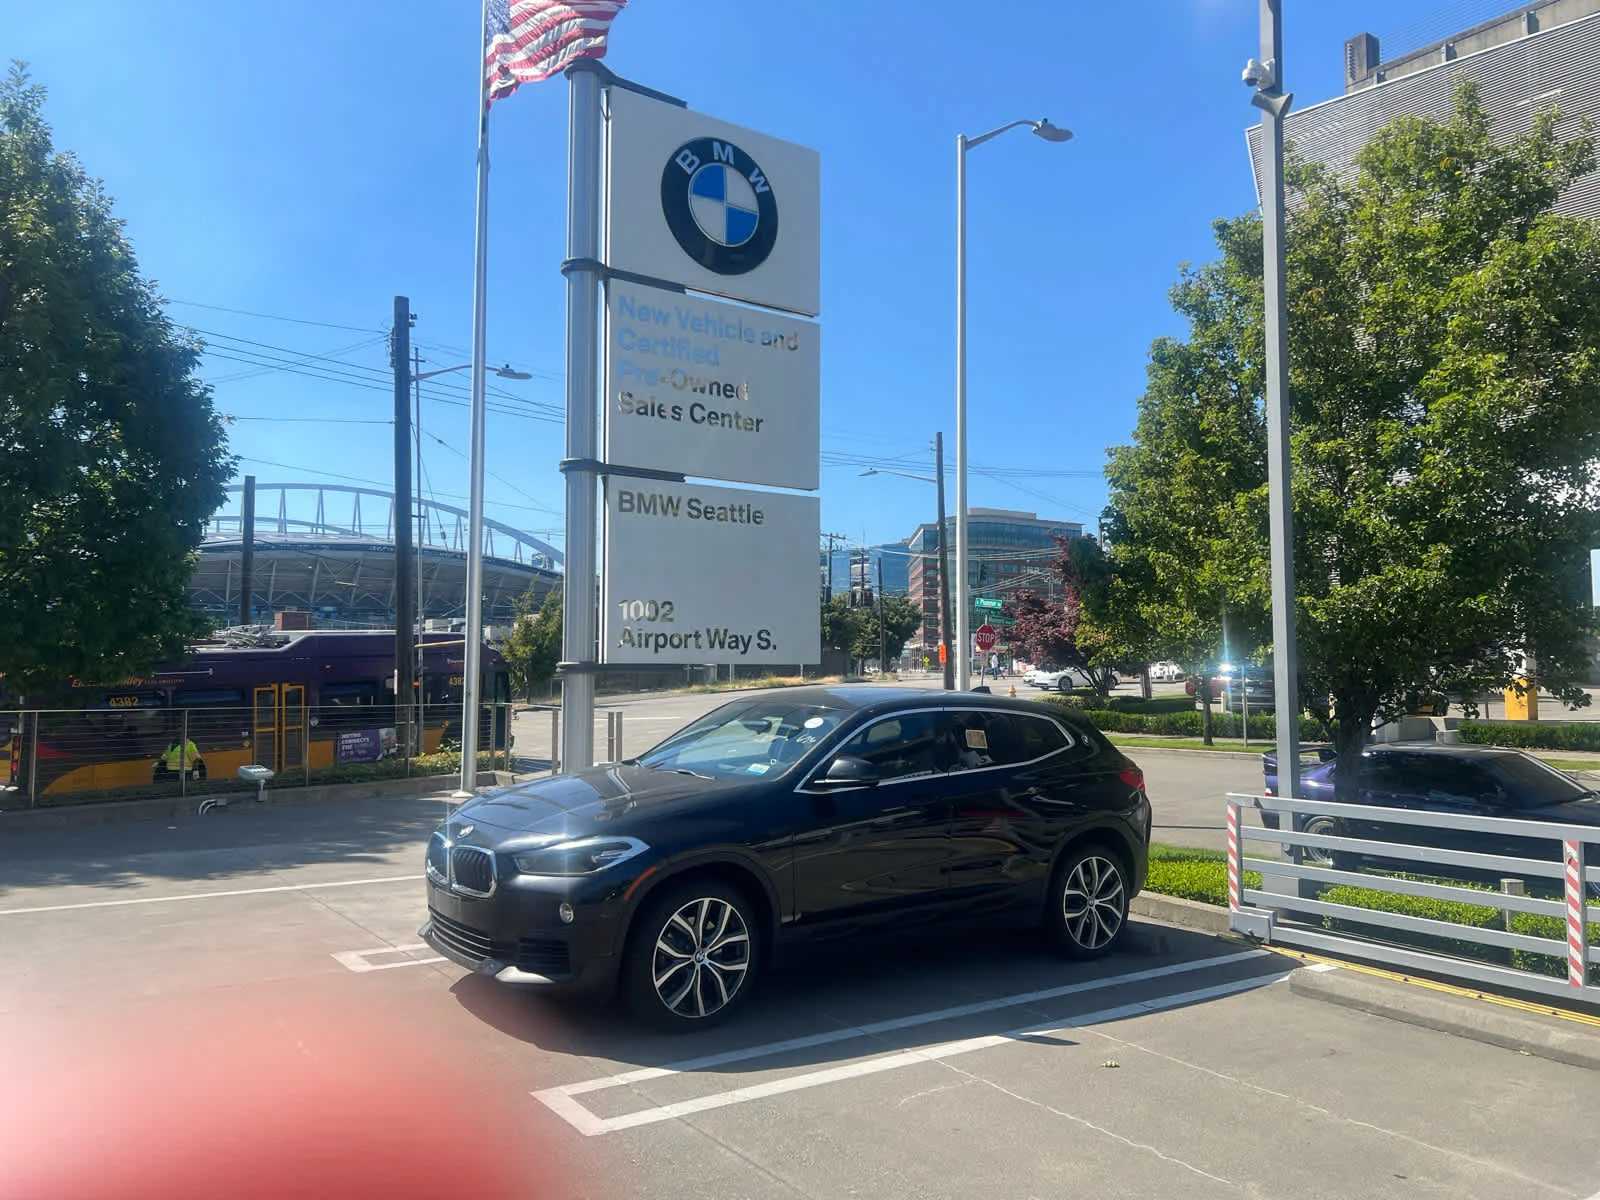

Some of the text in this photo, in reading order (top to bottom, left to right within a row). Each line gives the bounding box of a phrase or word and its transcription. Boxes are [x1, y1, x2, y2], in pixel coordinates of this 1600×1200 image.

[675, 141, 769, 194] BMW
[618, 295, 799, 351] New Vehicle and
[617, 327, 720, 367] Certified
[618, 359, 749, 401] Pre-Owned
[618, 391, 763, 432] Sales Center
[618, 490, 764, 525] BMW Seattle
[617, 600, 675, 622] 1002
[617, 626, 777, 655] Airport Way S.
[977, 632, 995, 643] STOP
